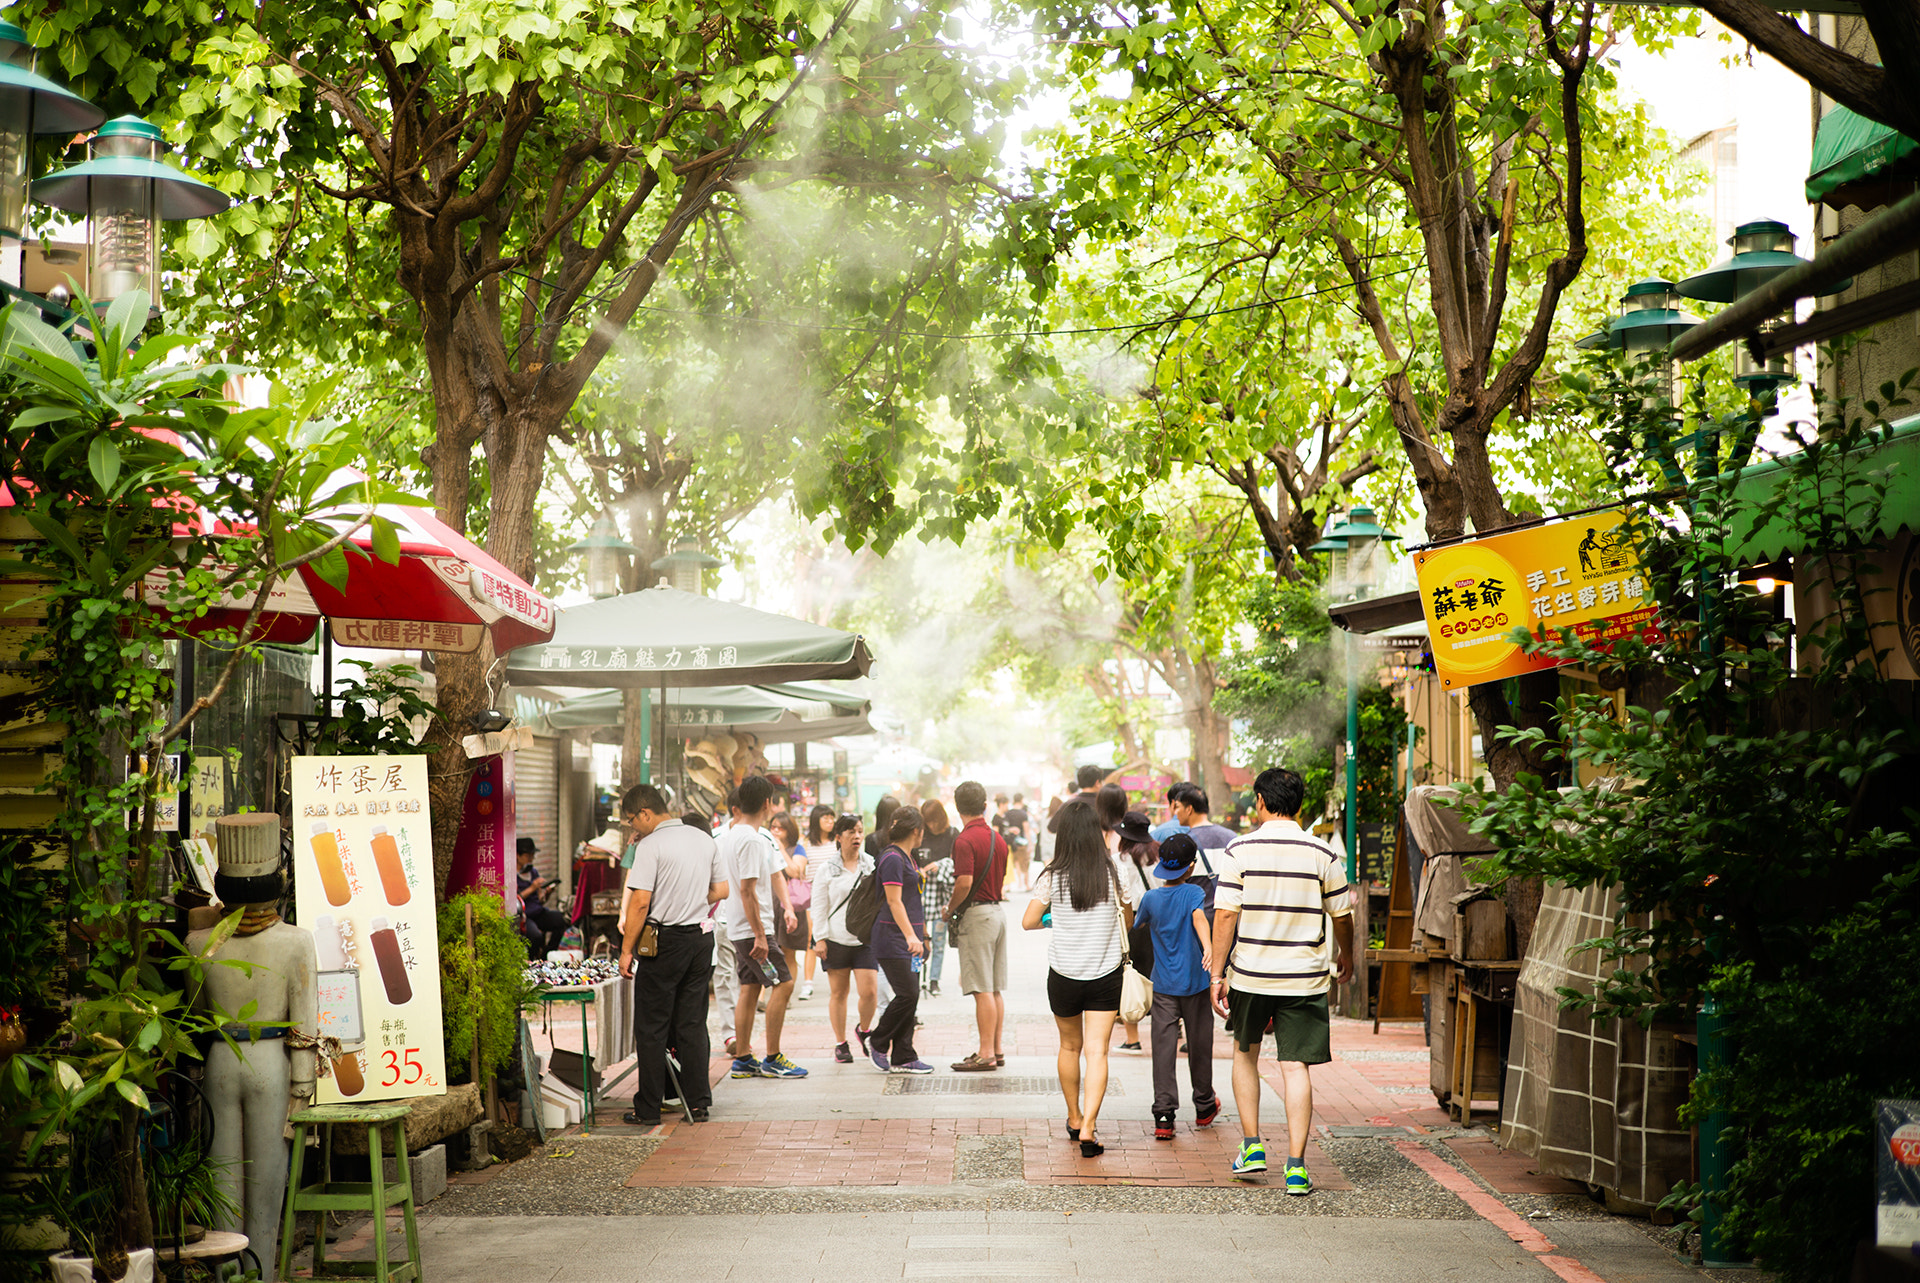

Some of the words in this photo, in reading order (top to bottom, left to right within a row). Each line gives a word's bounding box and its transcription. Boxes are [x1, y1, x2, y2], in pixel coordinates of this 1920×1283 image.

[1526, 566, 1571, 593] 手工
[1604, 566, 1630, 576] Handmad
[481, 572, 549, 624] 摩特動力
[1432, 578, 1506, 621] 蘇老爺
[1530, 576, 1644, 619] 花生麥芽糖
[1440, 612, 1508, 638] 三十年老店
[579, 645, 737, 669] 孔廟魅力商圈
[315, 764, 407, 794] 炸蛋屋
[304, 804, 329, 817] 天然
[335, 802, 360, 816] 養生
[366, 800, 390, 815] 簡單
[396, 799, 420, 813] 健康
[477, 823, 496, 897] 蛋酥麵
[340, 919, 360, 969] 薏仁水
[395, 921, 418, 970] 紅豆水
[380, 1018, 407, 1032] 每瓶
[382, 1032, 406, 1047] 售價
